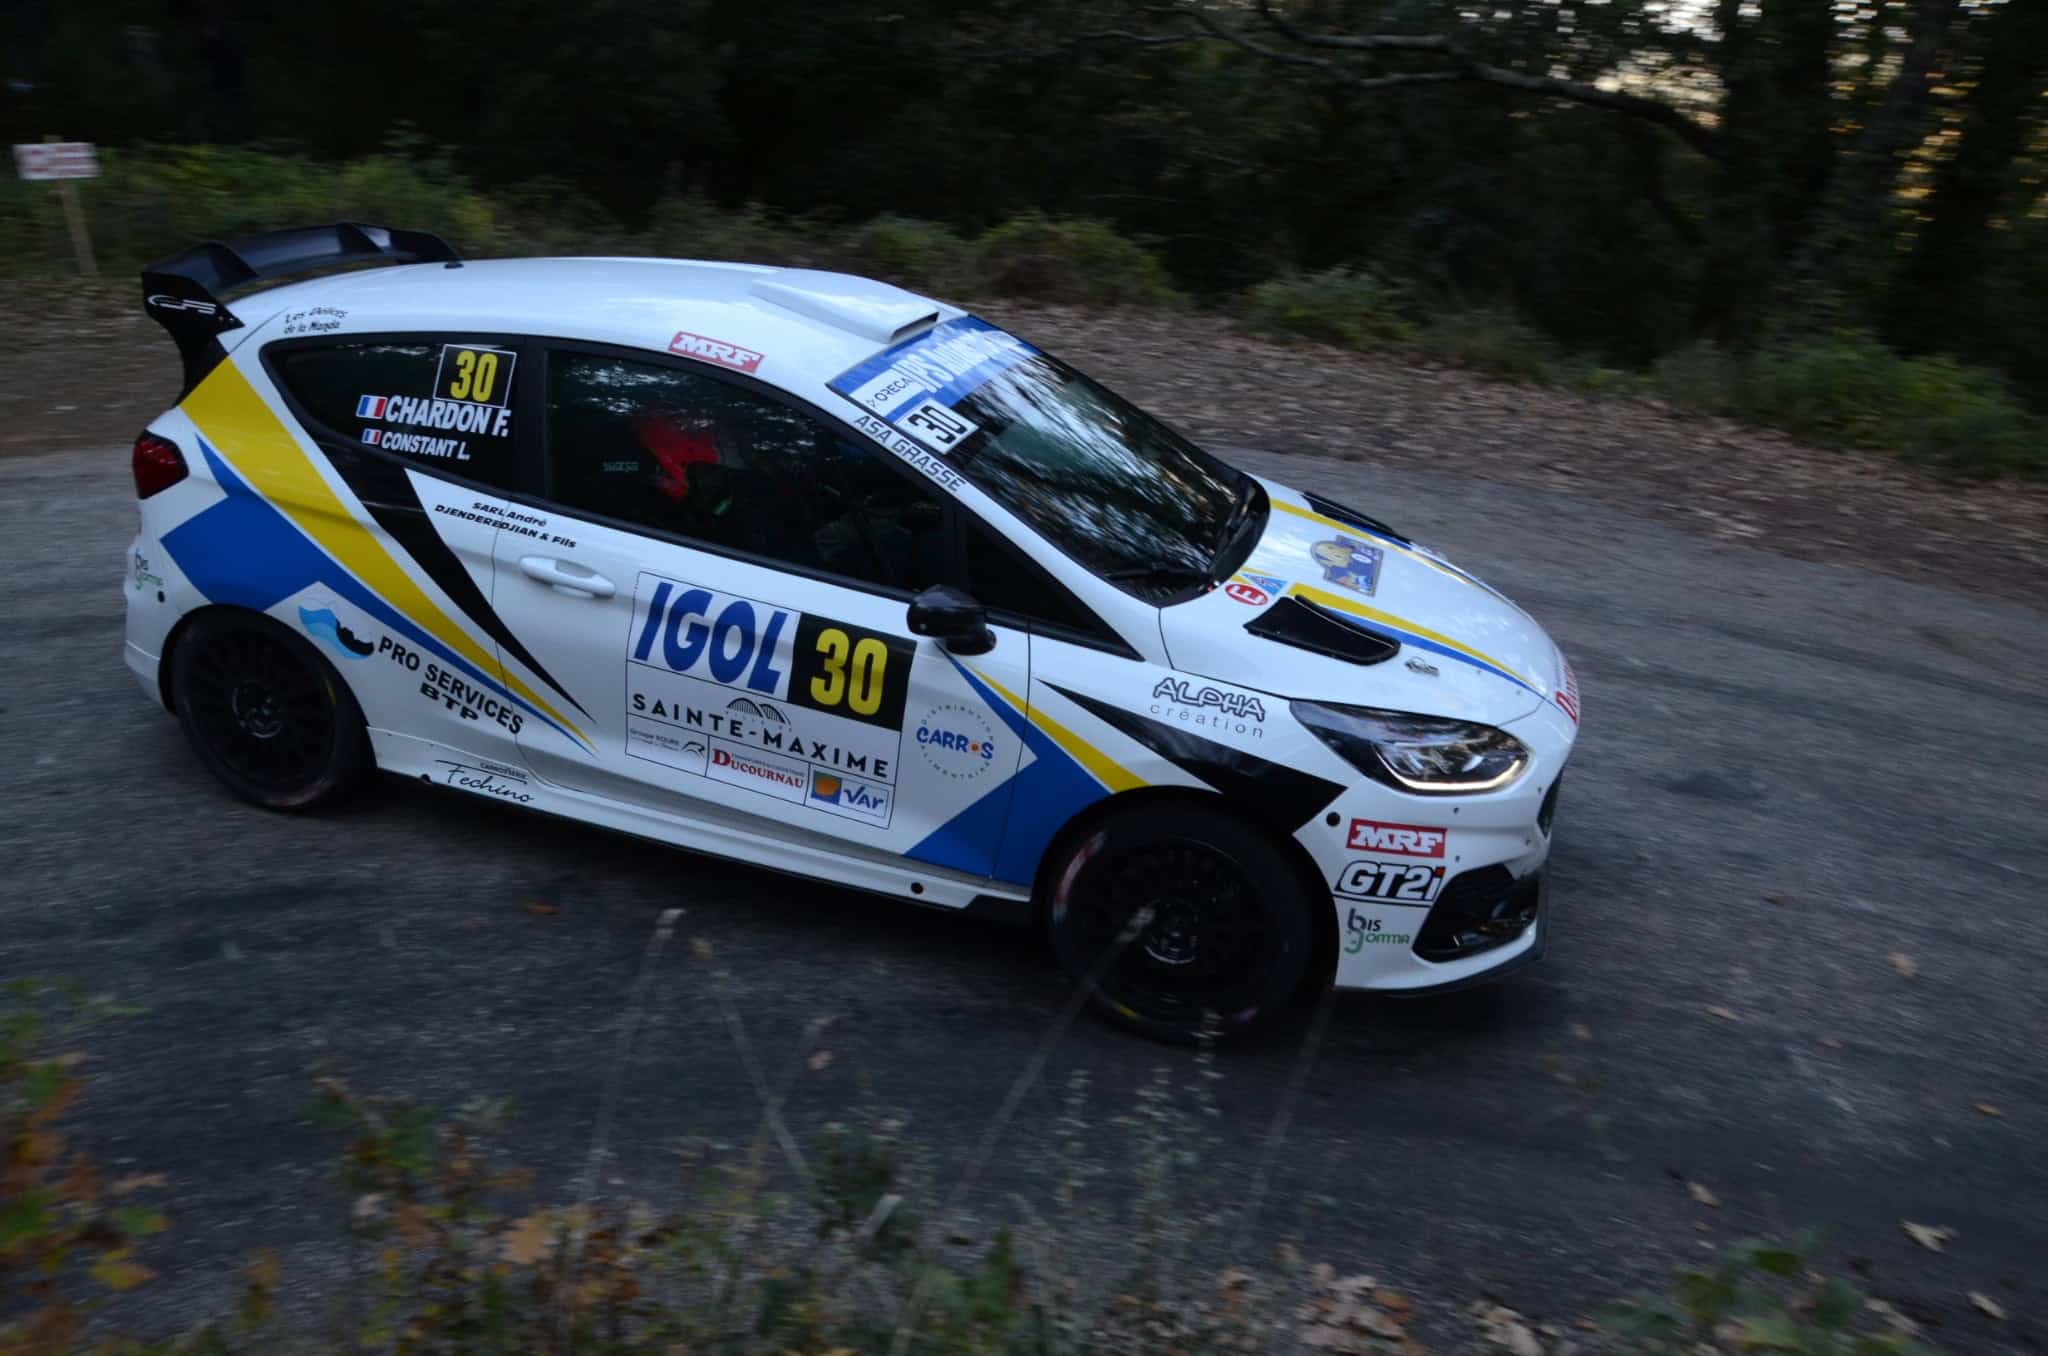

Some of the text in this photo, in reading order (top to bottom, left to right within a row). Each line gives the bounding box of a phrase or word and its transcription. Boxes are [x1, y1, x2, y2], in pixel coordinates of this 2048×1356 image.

[672, 333, 762, 366] MRF
[450, 350, 498, 402] 30
[385, 394, 512, 438] CHARDON F.
[908, 404, 968, 444] 30
[381, 431, 457, 458] CONSTANT
[853, 414, 968, 493] ASA GRASSE
[434, 504, 577, 548] DJENDEREDJIAN & Fils
[472, 501, 505, 517] SARL
[634, 582, 788, 694] IGOL
[378, 636, 524, 735] PRO SERVICES
[810, 628, 888, 716] 30
[419, 682, 479, 721] BTP
[1152, 677, 1266, 723] ALPHA
[632, 693, 889, 778] SAINTE-MAXIME
[712, 748, 804, 789] DUCOURNAU
[1350, 824, 1443, 855] MRF
[1333, 860, 1447, 902] GT2i
